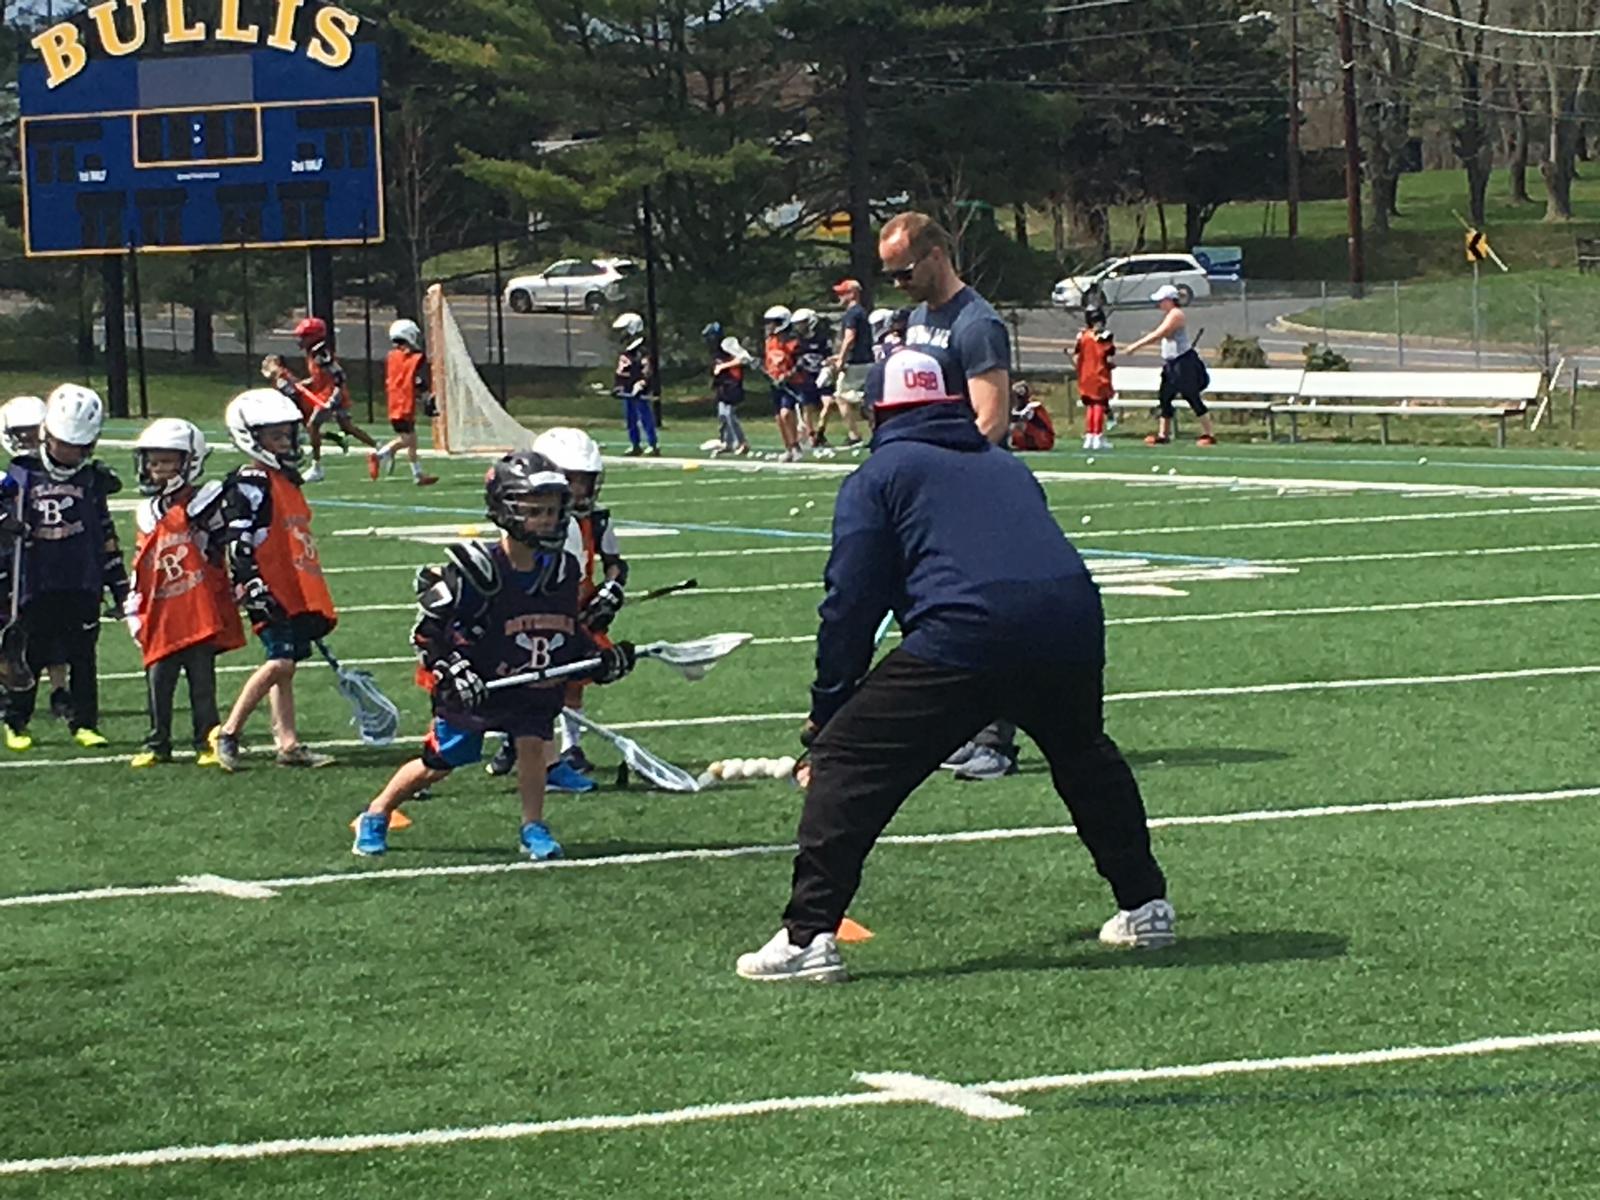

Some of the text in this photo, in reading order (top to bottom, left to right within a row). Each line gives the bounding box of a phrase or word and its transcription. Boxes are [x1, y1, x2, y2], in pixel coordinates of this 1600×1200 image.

[31, 0, 359, 89] BULLIS
[43, 499, 63, 525] B
[161, 553, 184, 582] B
[529, 636, 551, 669] B
